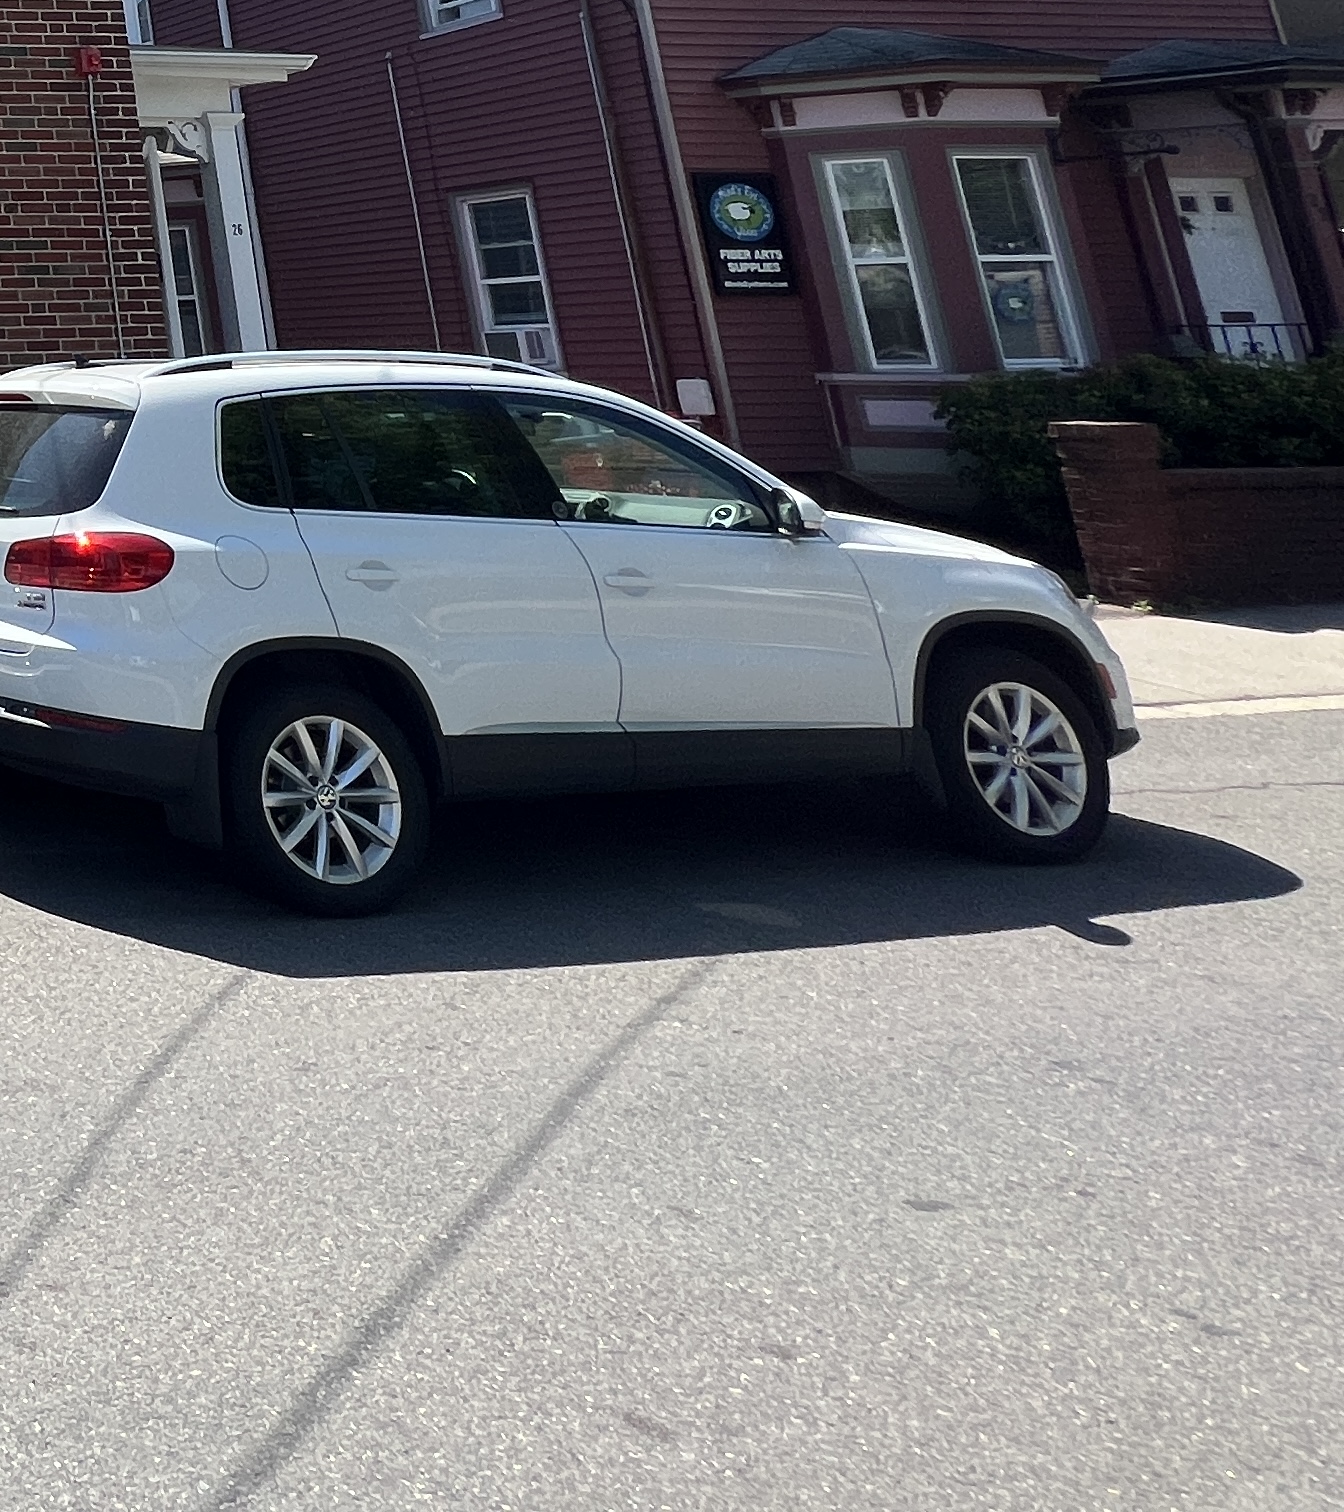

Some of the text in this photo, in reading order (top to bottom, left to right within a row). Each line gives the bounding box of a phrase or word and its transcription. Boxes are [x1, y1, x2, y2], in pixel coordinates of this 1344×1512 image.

[720, 249, 784, 260] FIBER ARTS
[727, 262, 782, 273] SUPPLIES
